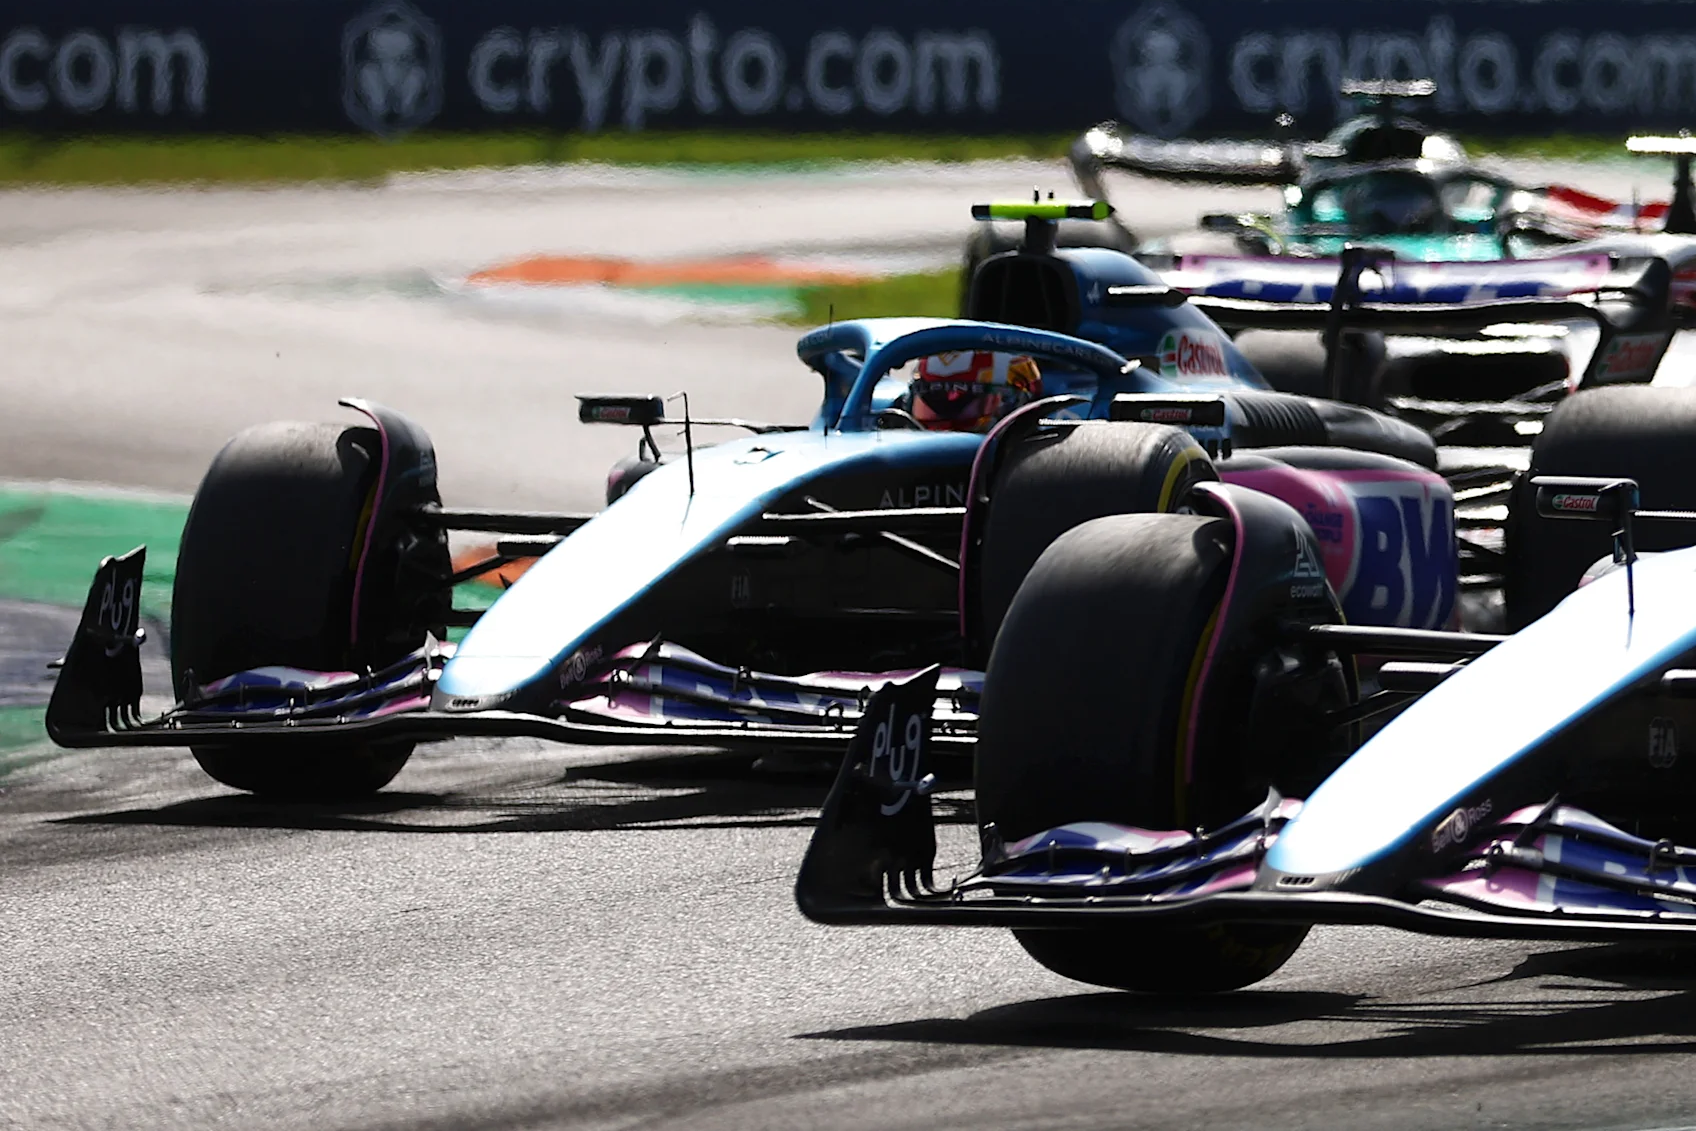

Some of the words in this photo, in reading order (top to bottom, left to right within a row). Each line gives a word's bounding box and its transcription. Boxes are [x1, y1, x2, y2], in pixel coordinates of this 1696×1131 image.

[469, 13, 996, 132] crypto.com
[879, 484, 965, 509] ALPIN
[1562, 495, 1595, 511] Castrol
[868, 702, 922, 817] plug
